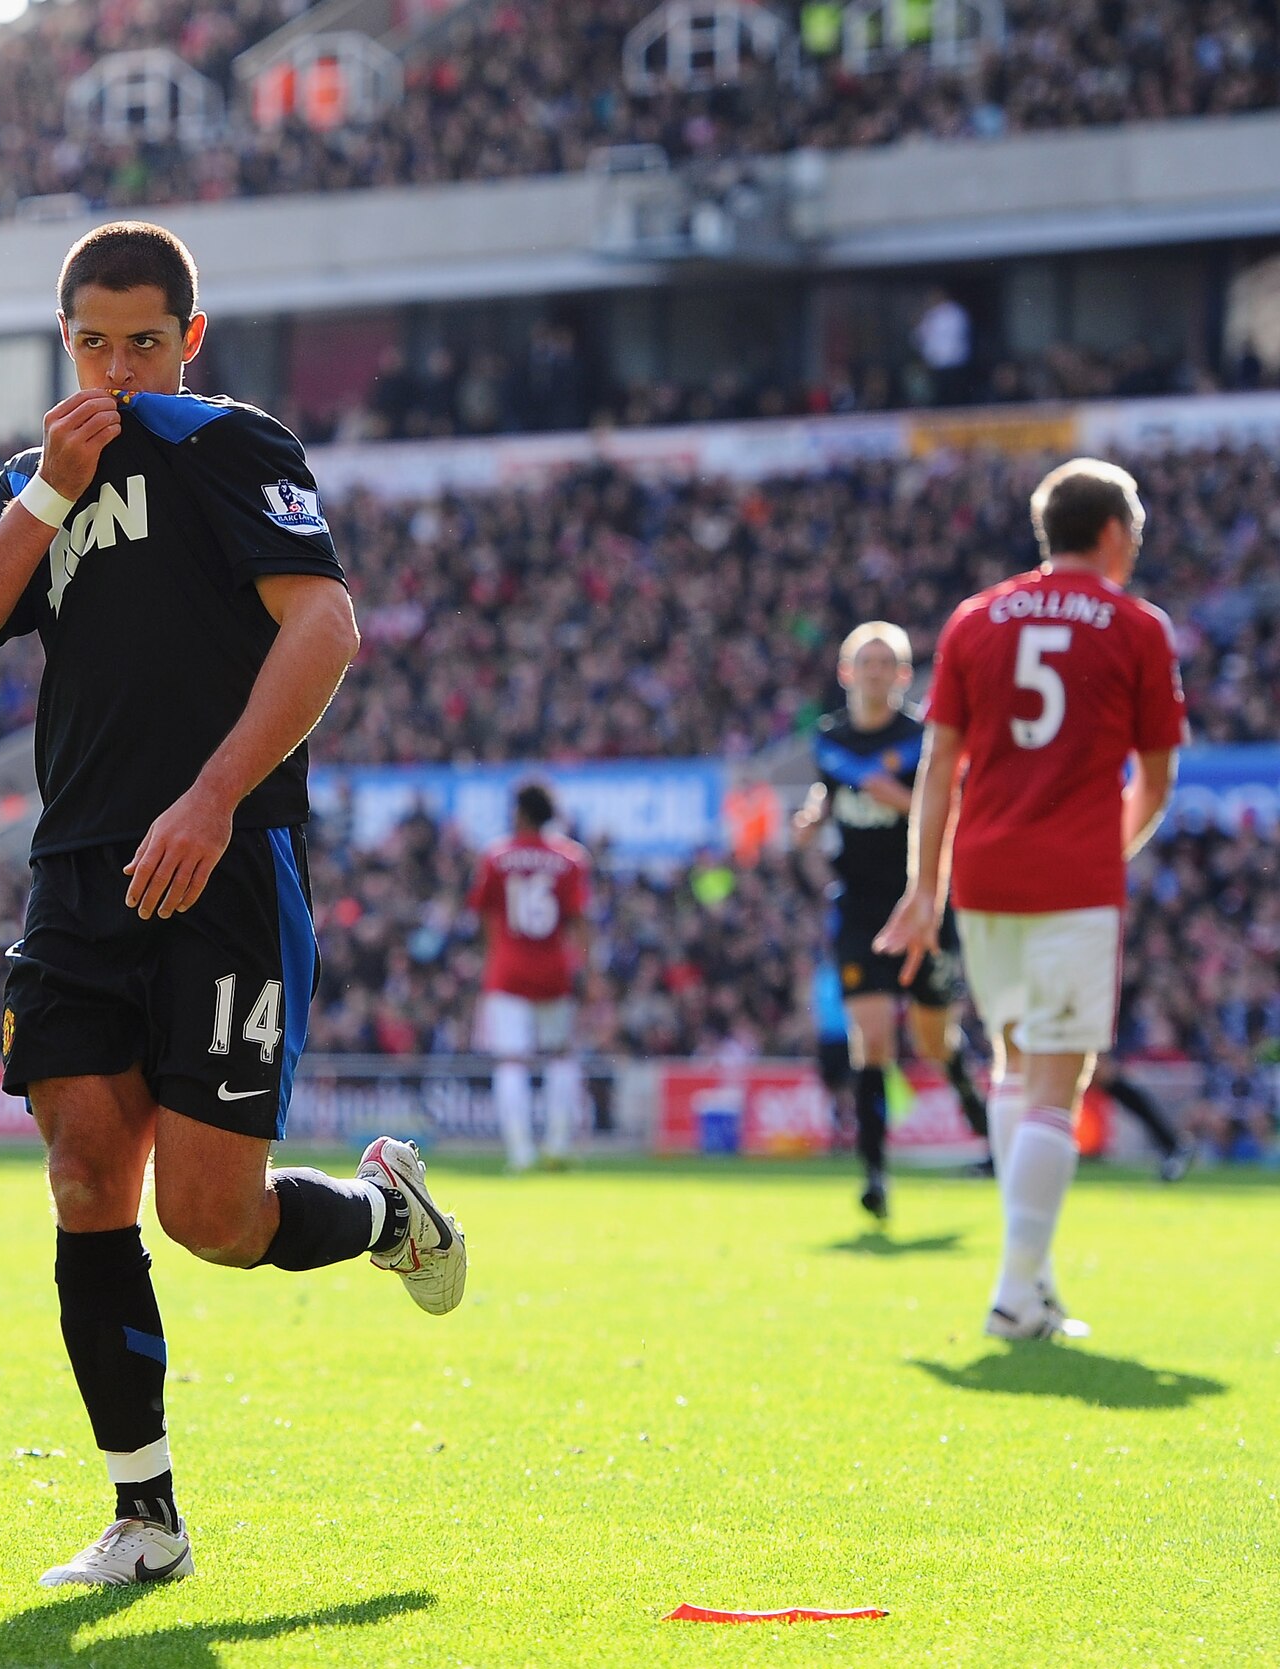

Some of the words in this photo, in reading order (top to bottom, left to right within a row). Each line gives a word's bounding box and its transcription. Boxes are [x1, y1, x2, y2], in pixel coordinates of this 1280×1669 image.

[989, 590, 1115, 630] COLLINS
[1010, 624, 1072, 750] 5
[505, 874, 560, 941] 16
[208, 973, 282, 1064] 14
